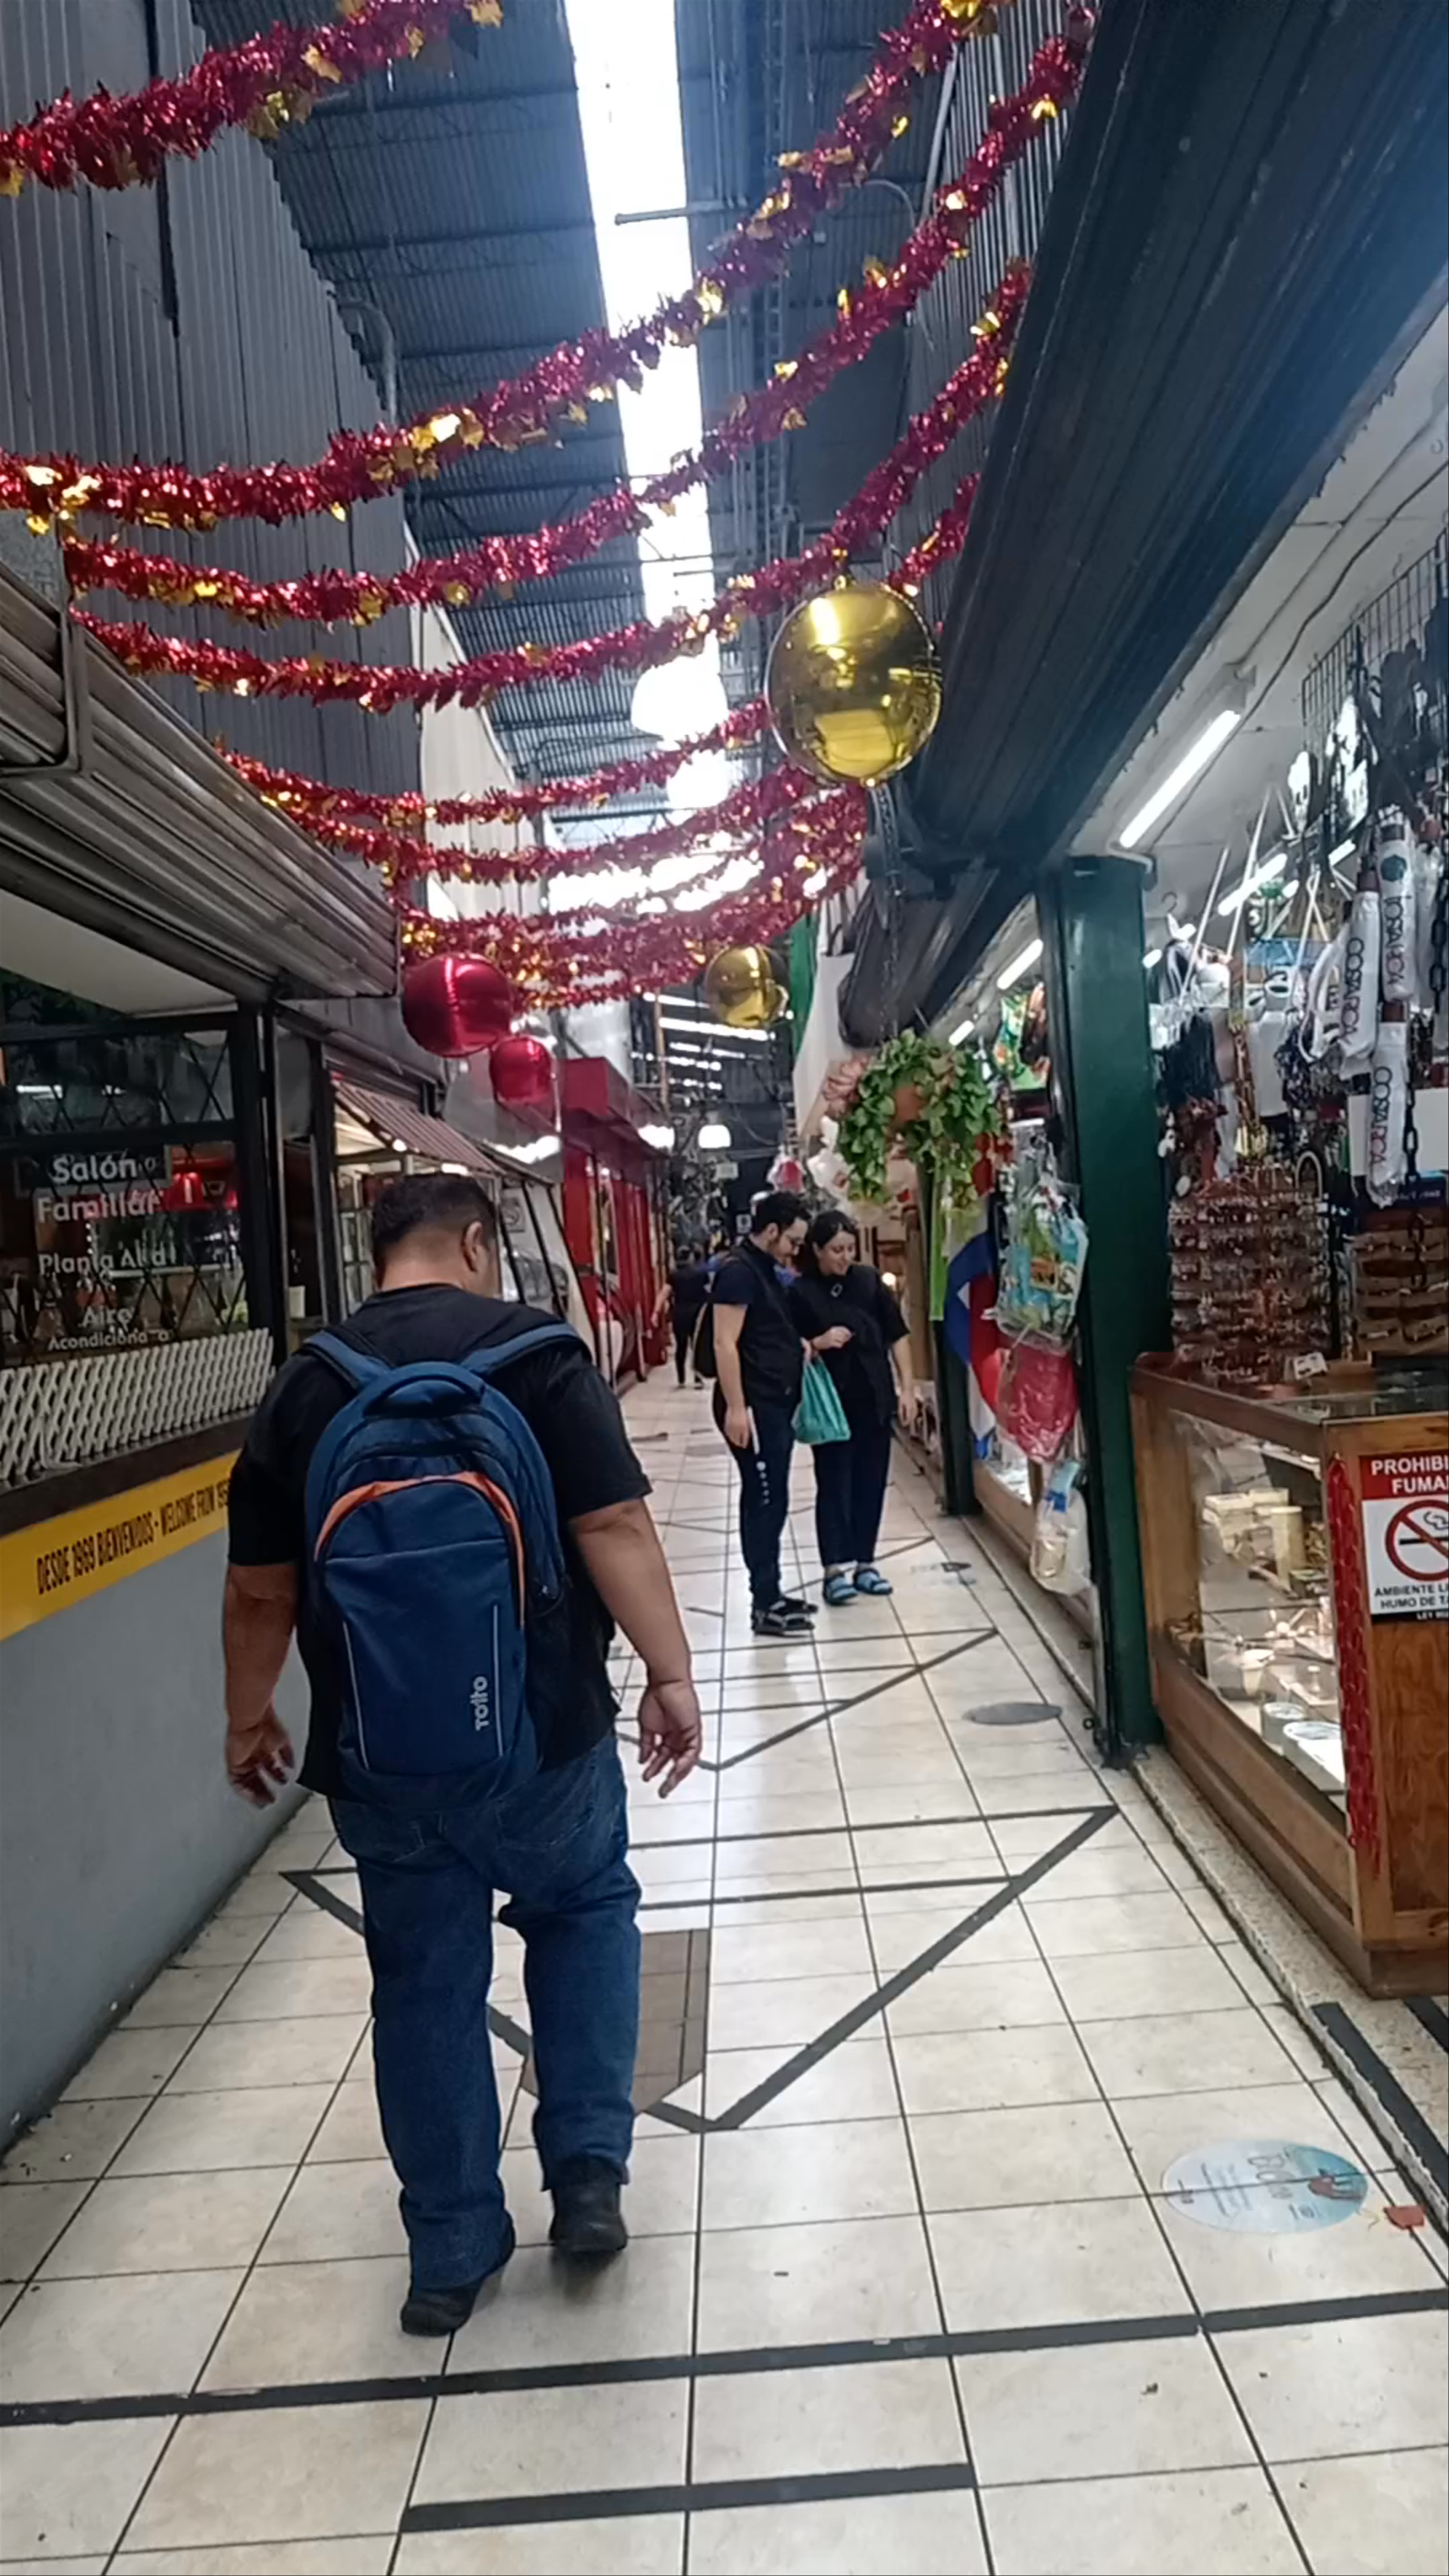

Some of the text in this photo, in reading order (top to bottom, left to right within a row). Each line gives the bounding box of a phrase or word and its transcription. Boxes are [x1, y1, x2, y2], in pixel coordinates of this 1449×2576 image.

[52, 1154, 137, 1184] Salón
[37, 1191, 161, 1223] Familiar
[1391, 1475, 1448, 1495] FUMA
[37, 1545, 70, 1595] DESDE
[97, 1510, 154, 1567] BIENVENIDOS
[160, 1492, 196, 1537] WELCOME
[196, 1484, 215, 1519] FROM
[1374, 1584, 1435, 1597] AMBIENTE
[1380, 1597, 1417, 1609] HUMO
[1420, 1596, 1435, 1607] DE
